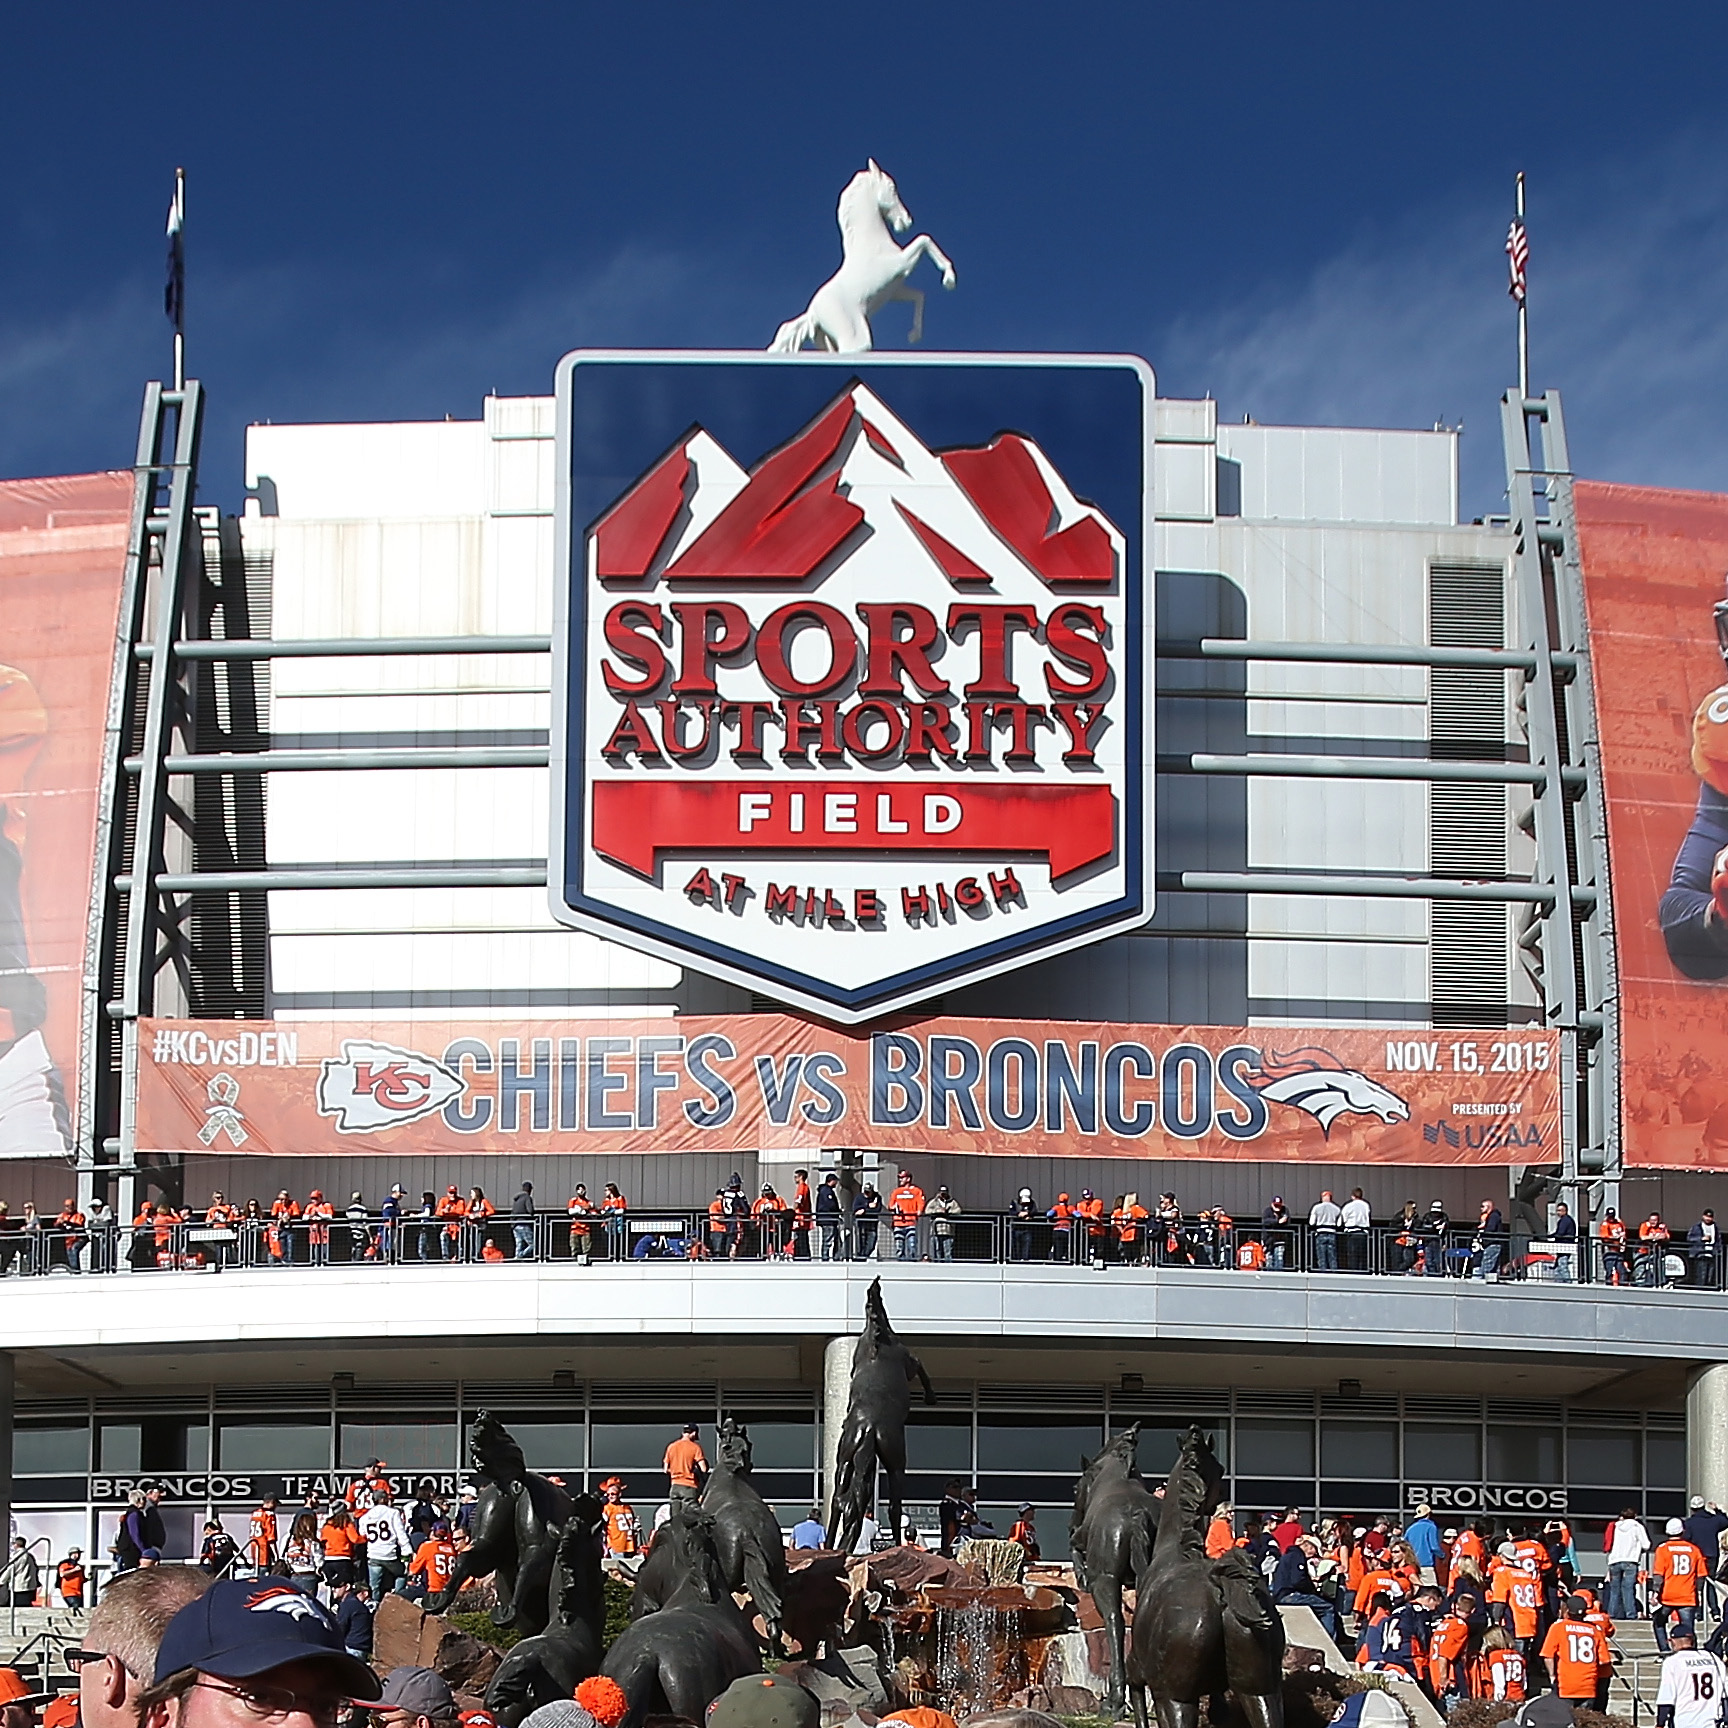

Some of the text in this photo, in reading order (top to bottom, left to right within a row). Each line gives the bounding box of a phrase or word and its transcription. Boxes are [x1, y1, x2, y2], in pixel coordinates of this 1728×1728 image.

[600, 600, 1114, 700] SPORTS
[601, 700, 1108, 768] AUTHORITY
[738, 793, 964, 833] FIELD
[683, 867, 1024, 924] AT MILE HIGH
[152, 1029, 298, 1067] #KCvsDEN
[1385, 1041, 1551, 1077] NOV. 15, 2015
[352, 1061, 431, 1111] KC
[440, 1033, 737, 1133] CHIEFS
[870, 1029, 1270, 1142] BRONCOS
[1452, 1102, 1523, 1115] PRESENTED BY
[1465, 1123, 1544, 1149] USAA
[92, 1475, 471, 1498] BRONCOS TEAM STORE
[1407, 1486, 1569, 1509] BRONCOS
[366, 1520, 392, 1544] 58
[434, 1553, 456, 1576] 58
[1672, 1554, 1691, 1576] 18
[1513, 1583, 1536, 1608] 88
[1568, 1634, 1594, 1663] 18
[1692, 1671, 1715, 1701] 18
